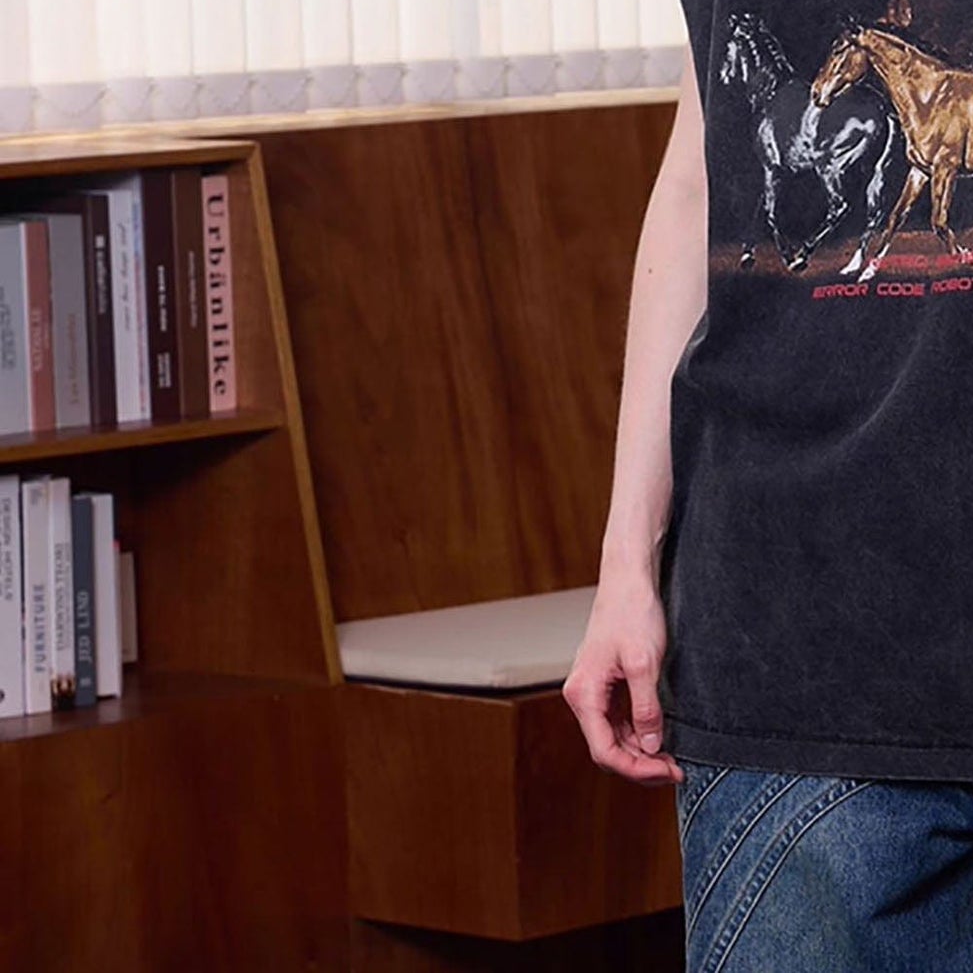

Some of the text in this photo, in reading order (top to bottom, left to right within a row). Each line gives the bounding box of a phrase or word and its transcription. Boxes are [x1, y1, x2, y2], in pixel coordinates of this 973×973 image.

[812, 284, 868, 299] ERROR
[877, 283, 925, 297] CODE
[34, 583, 46, 673] FURNITURE
